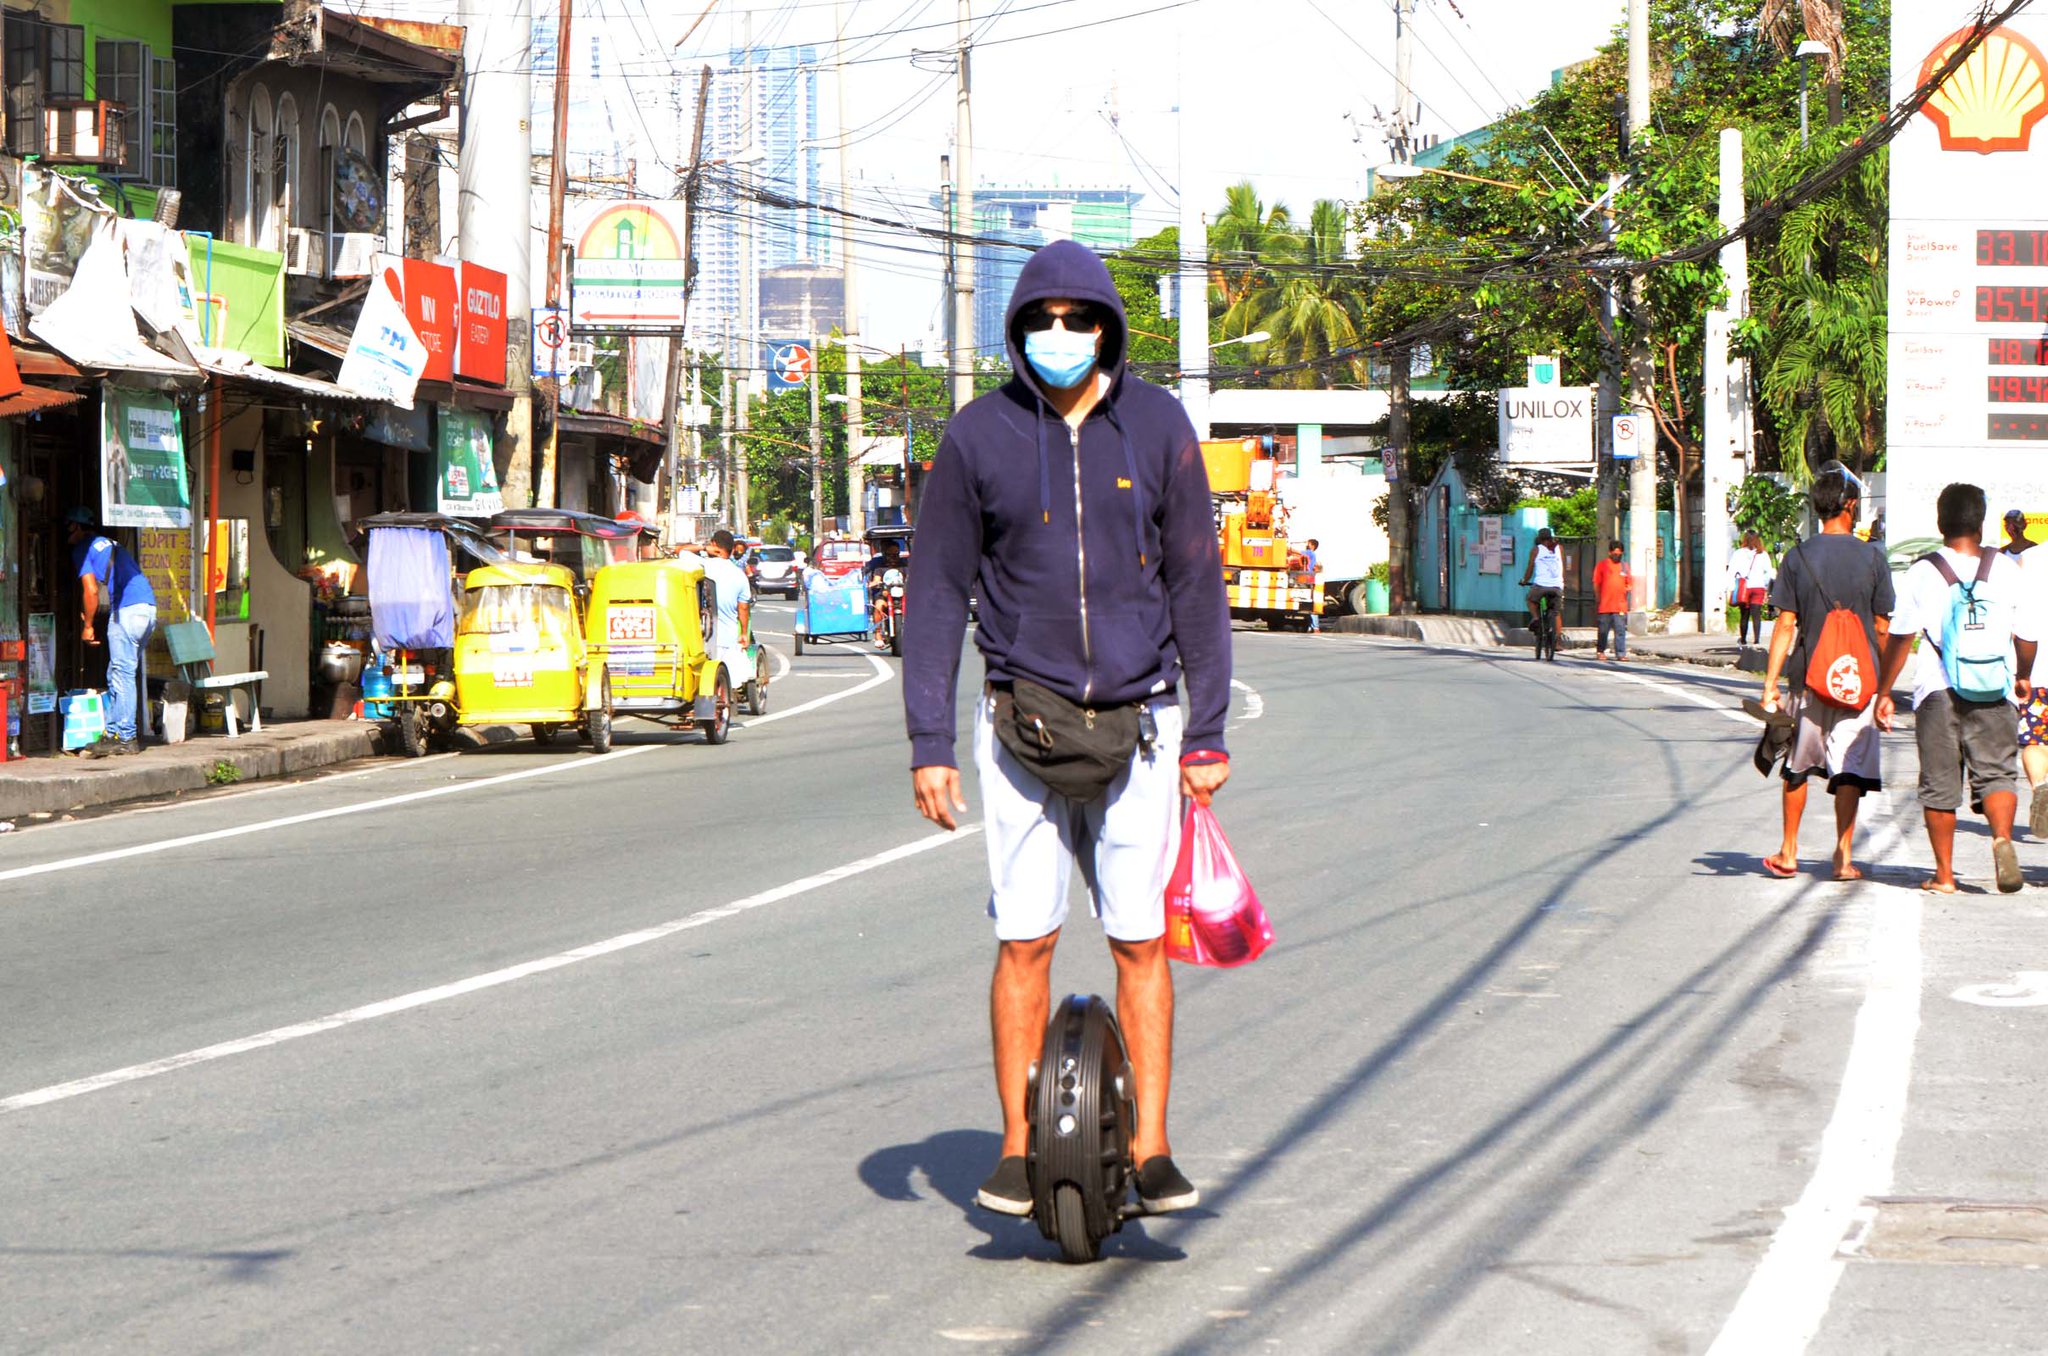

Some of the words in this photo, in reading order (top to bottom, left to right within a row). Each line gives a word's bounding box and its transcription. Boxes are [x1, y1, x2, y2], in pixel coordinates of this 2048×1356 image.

[1906, 241, 1958, 251] FuelSave
[467, 287, 500, 320] GUZTILO
[1906, 297, 1956, 306] V-Power
[380, 325, 409, 352] TM
[1505, 400, 1582, 420] UNILOX
